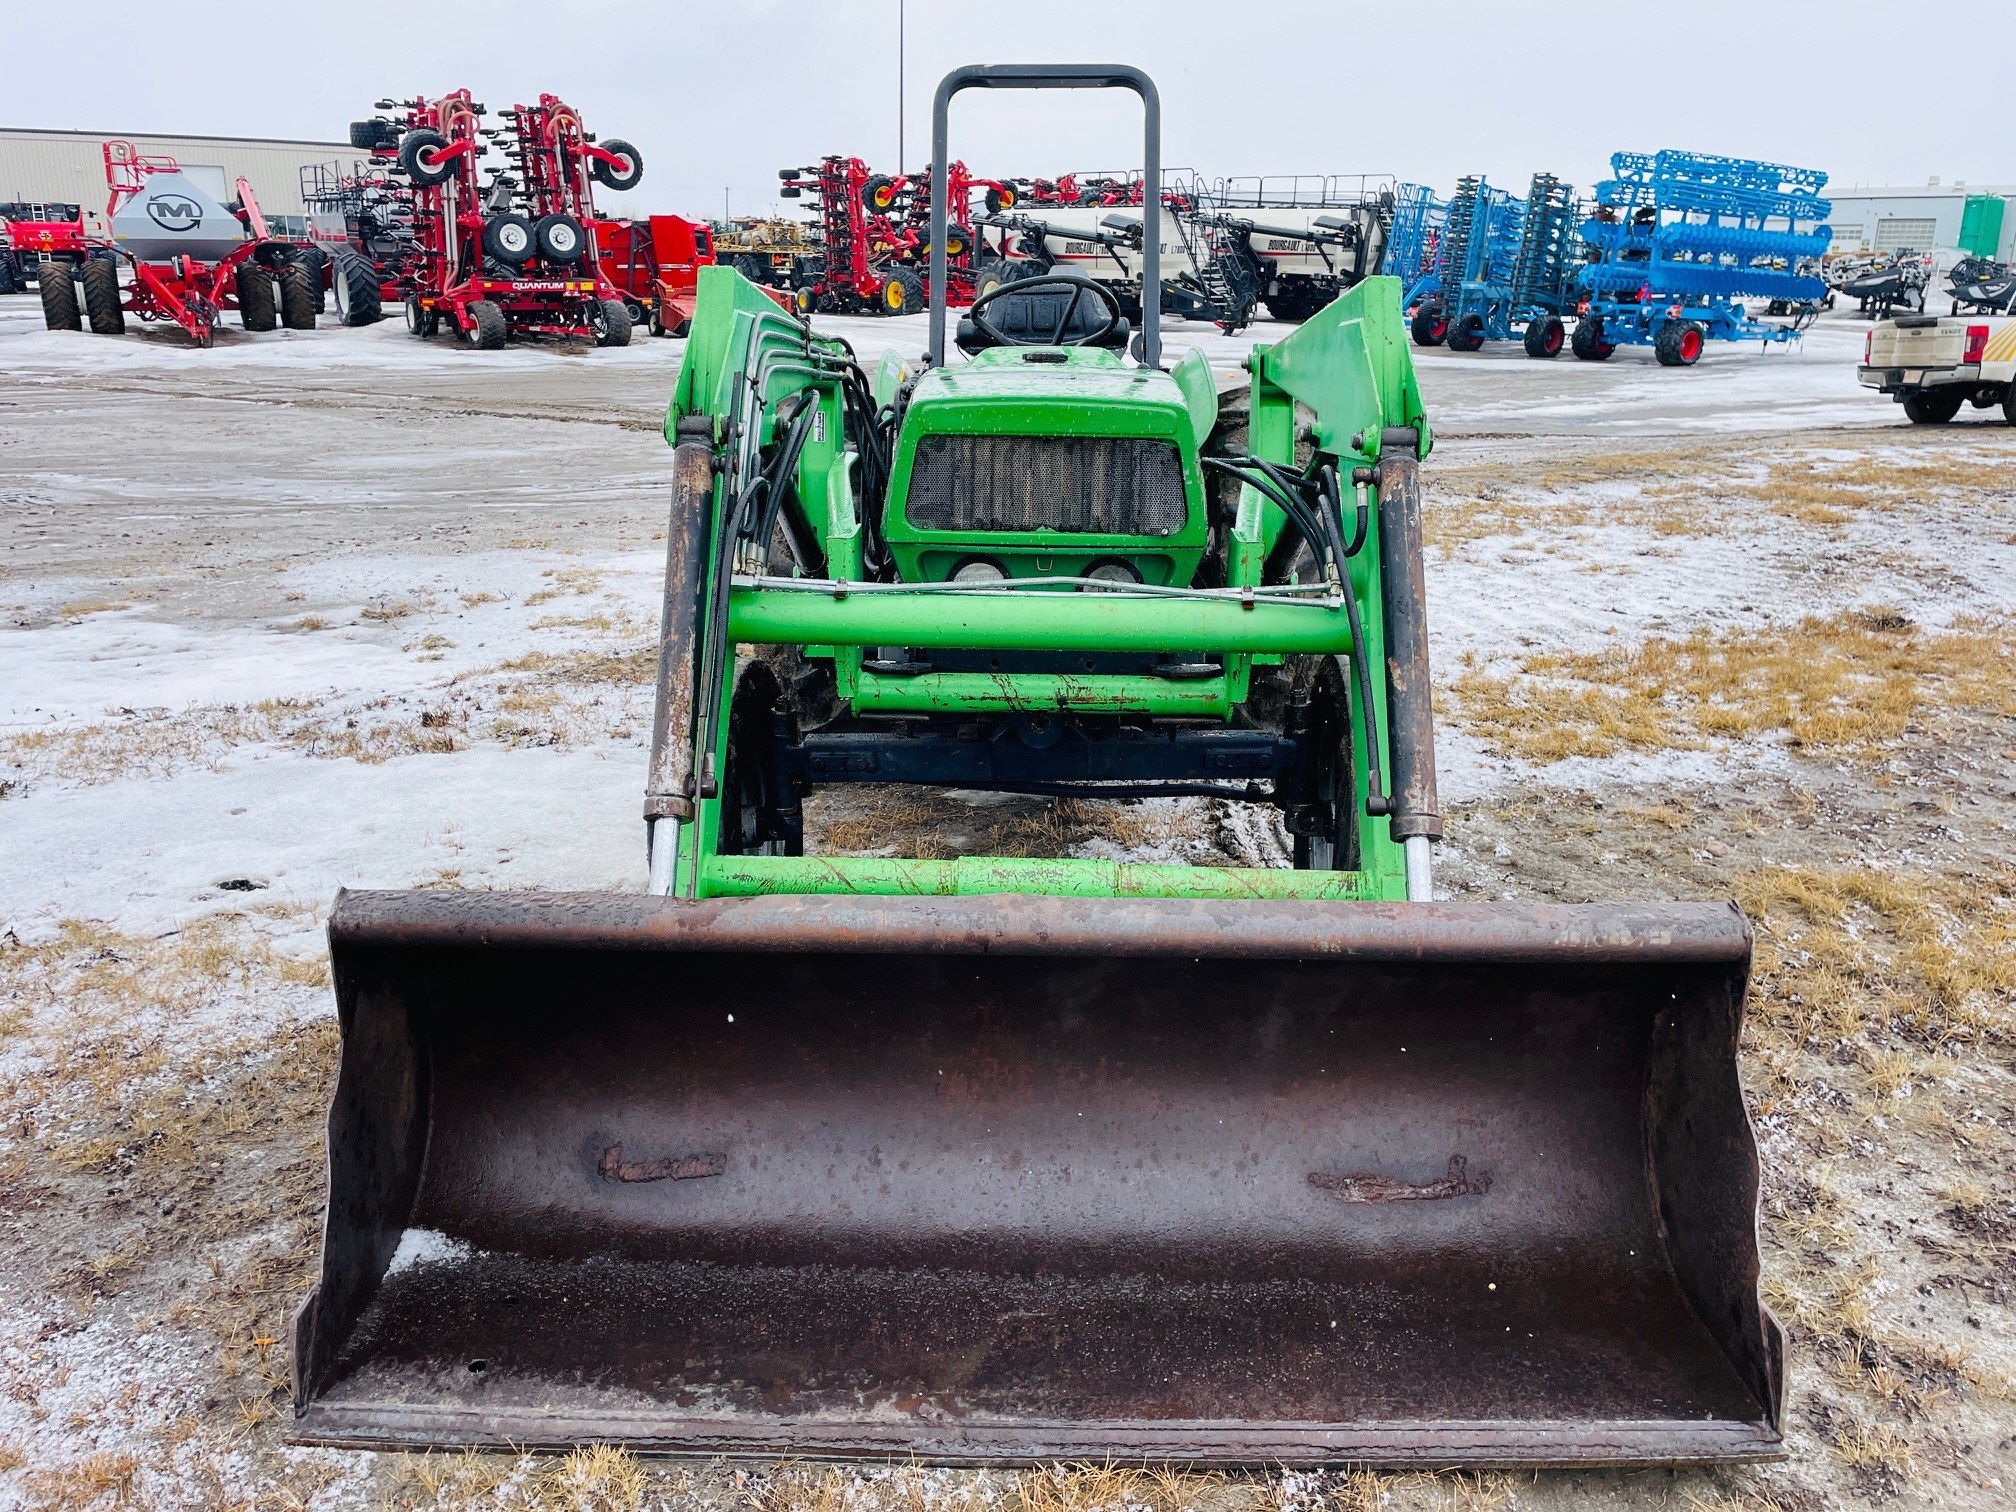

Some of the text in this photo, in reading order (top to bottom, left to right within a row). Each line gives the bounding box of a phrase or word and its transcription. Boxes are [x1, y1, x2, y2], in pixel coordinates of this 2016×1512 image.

[1065, 242, 1095, 254] BOURGAULT
[1171, 245, 1185, 254] L7800
[1268, 239, 1315, 252] BOURGAULT L7800
[512, 282, 564, 290] QUANTUM
